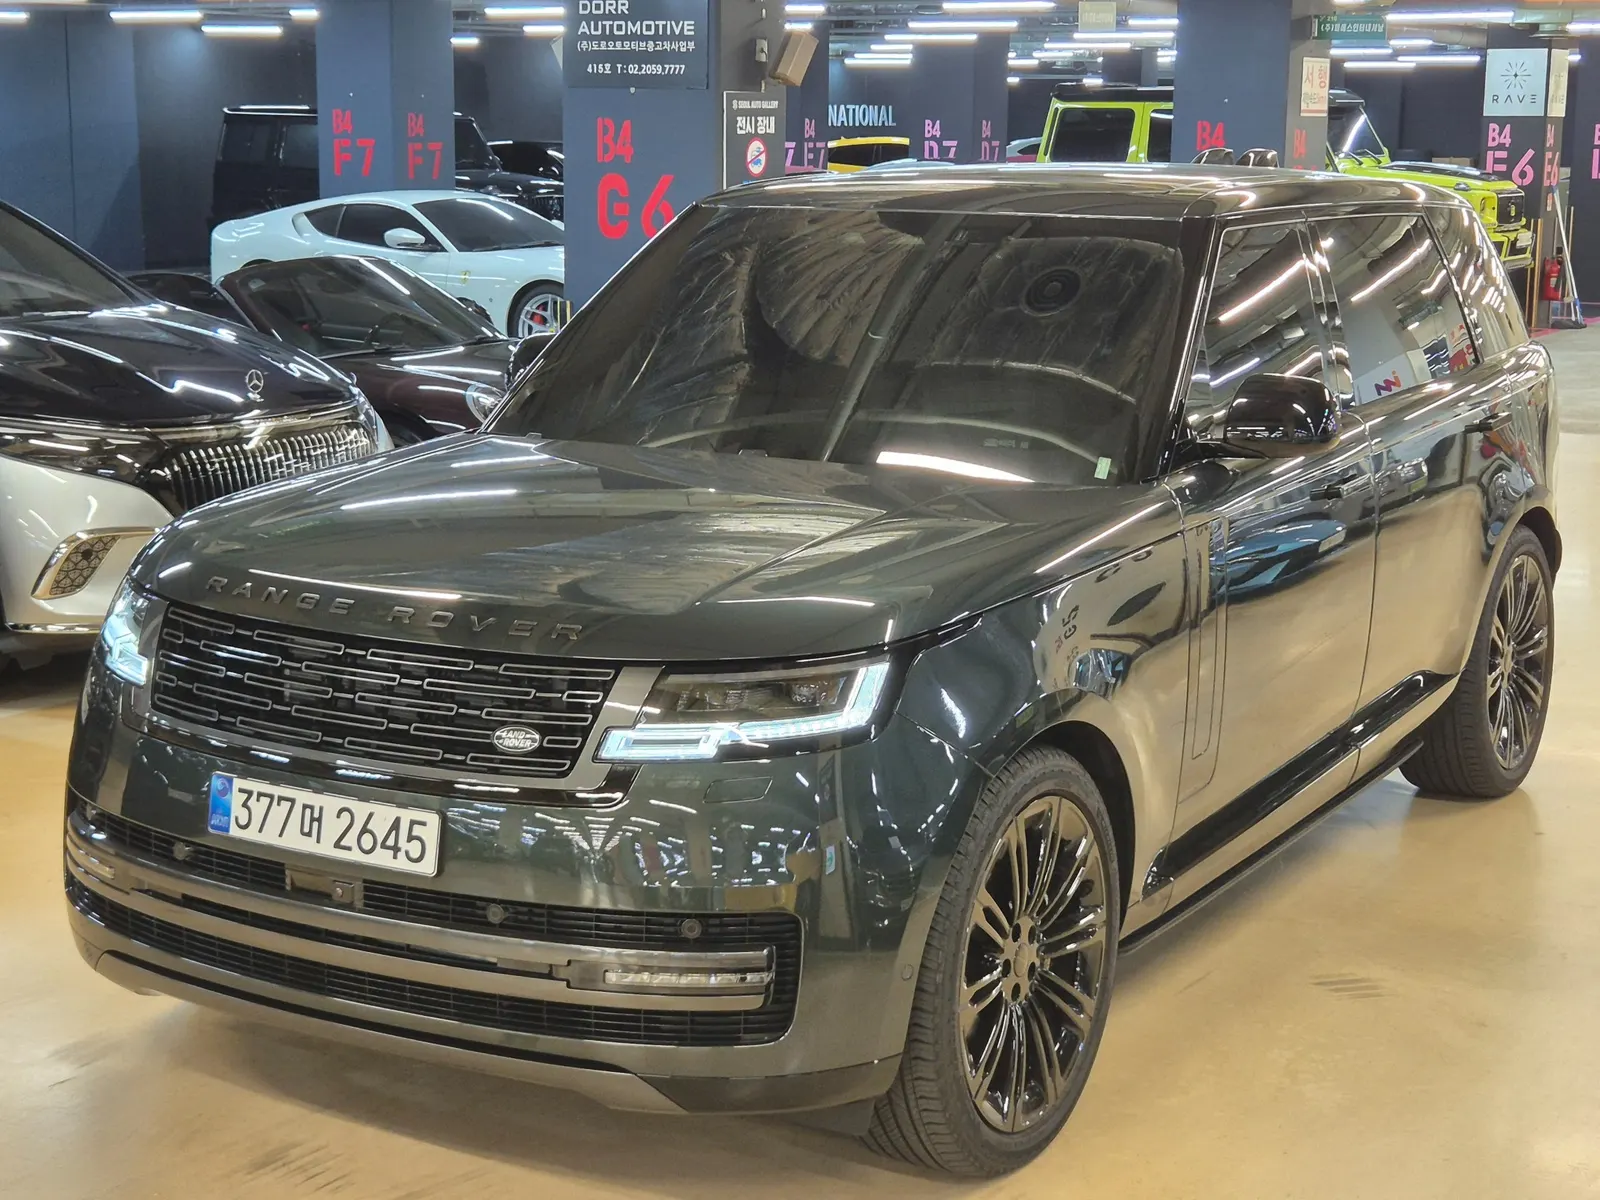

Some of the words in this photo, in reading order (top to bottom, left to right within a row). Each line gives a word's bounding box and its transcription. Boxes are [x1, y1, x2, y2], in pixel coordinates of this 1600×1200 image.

[578, 0, 630, 14] DORR
[577, 20, 696, 36] AUTOMOTIVE
[1491, 94, 1537, 104] RAVE
[332, 108, 353, 134] B4
[407, 112, 424, 137] B4
[736, 116, 755, 134] 전시
[804, 117, 815, 138] B4
[828, 104, 896, 127] NATIONAL
[597, 117, 634, 163] B4
[924, 119, 941, 138] B4
[981, 119, 991, 138] B4
[1196, 120, 1226, 151] B4
[1487, 123, 1512, 148] B4
[1293, 128, 1307, 158] B4
[333, 138, 376, 177] F7
[407, 142, 443, 179] F7
[597, 172, 675, 239] G6
[205, 575, 356, 615] RANGE
[387, 605, 583, 640] ROVER
[502, 730, 526, 739] LAND
[502, 738, 532, 748] ROVER
[333, 806, 428, 864] 2645
